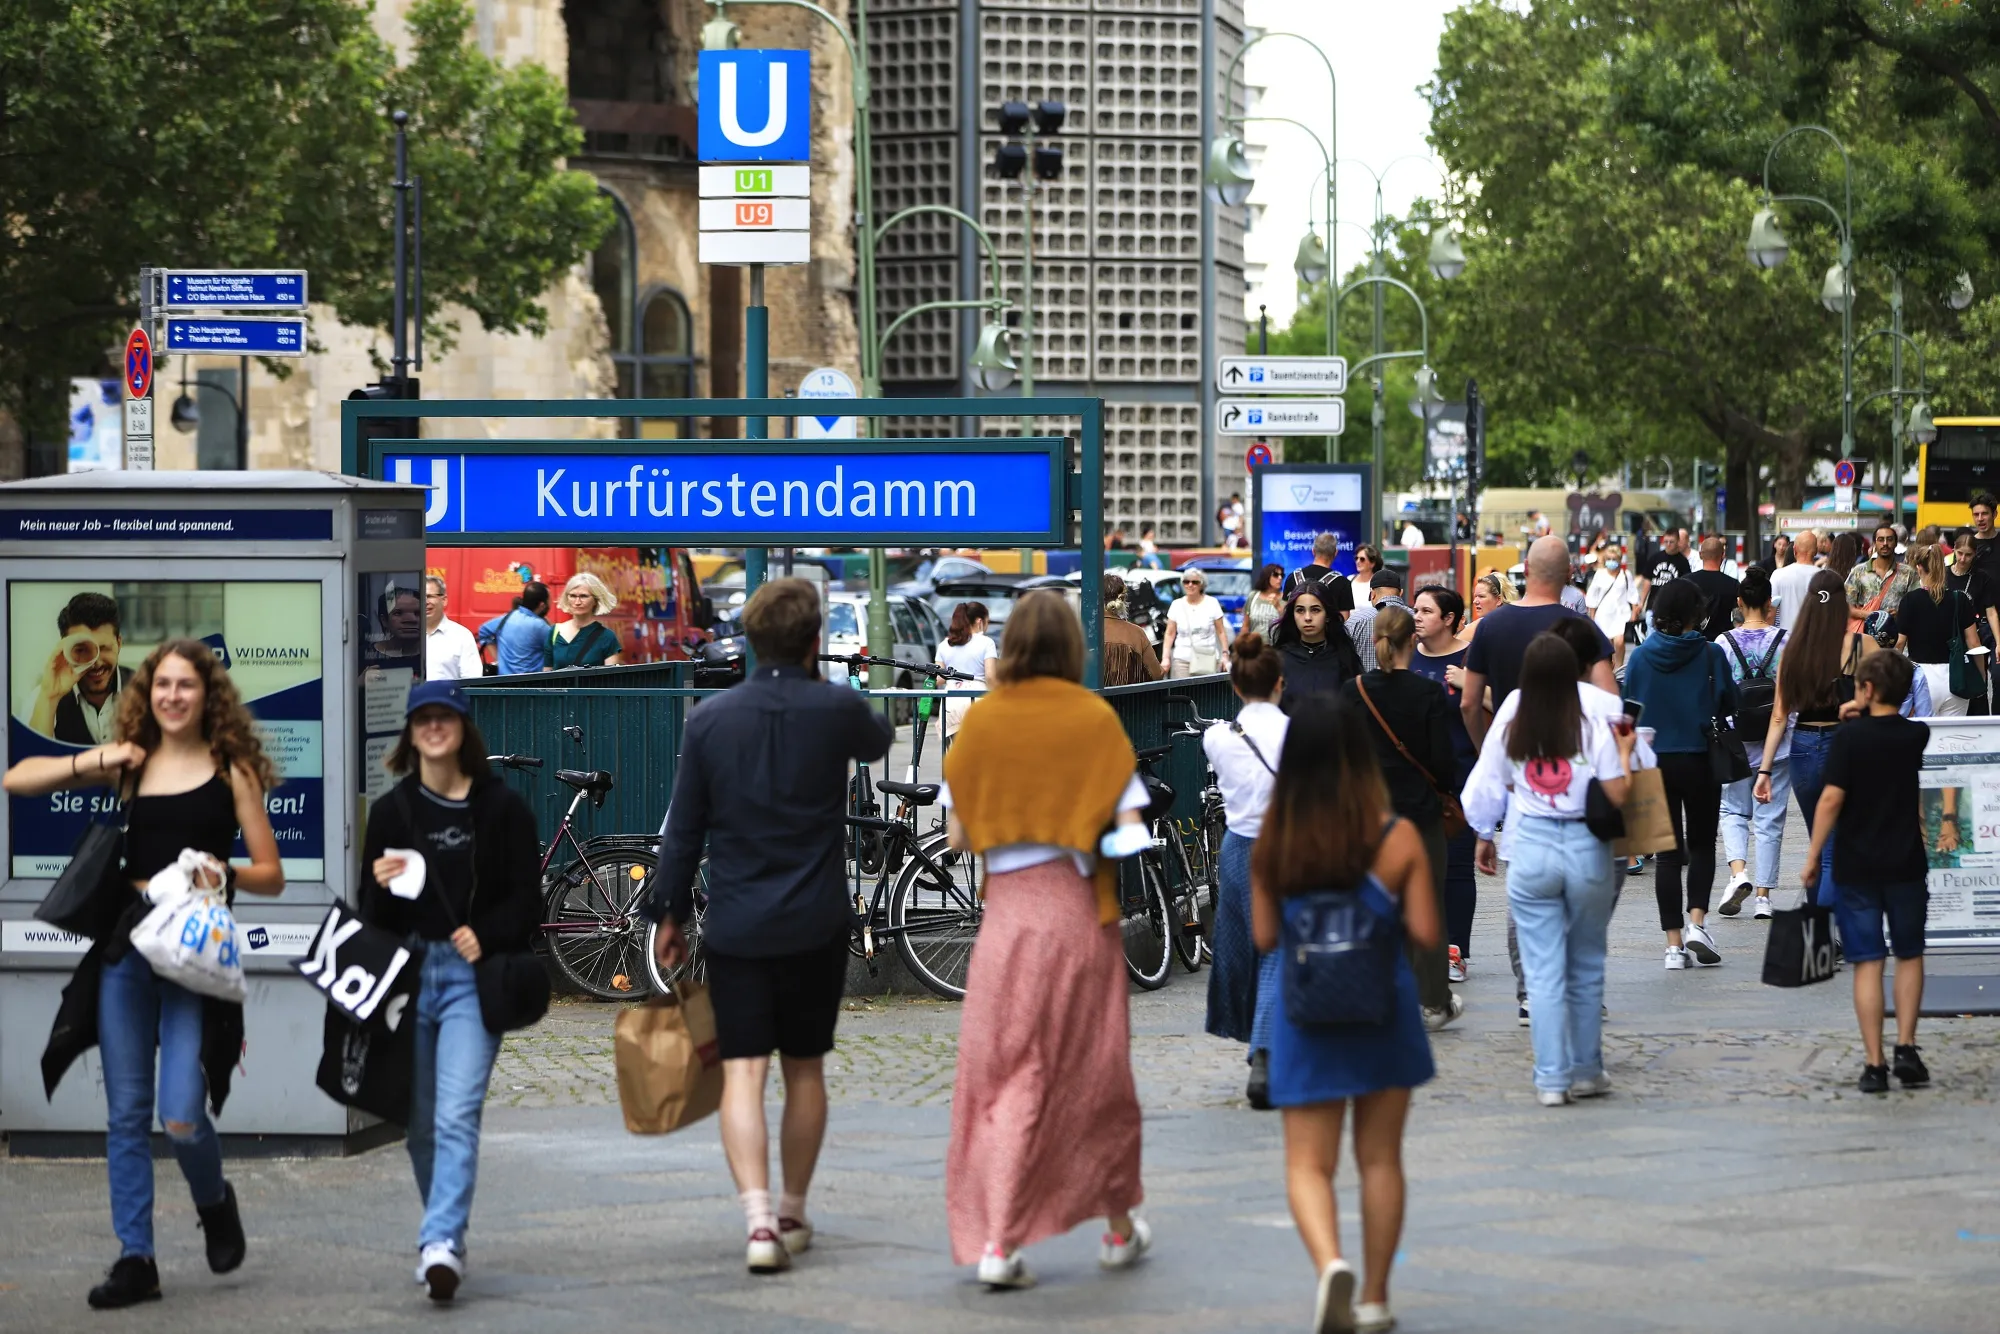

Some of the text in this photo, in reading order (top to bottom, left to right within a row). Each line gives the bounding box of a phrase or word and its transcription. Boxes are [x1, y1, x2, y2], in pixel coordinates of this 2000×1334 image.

[719, 62, 787, 147] U
[739, 172, 768, 190] U1
[740, 206, 769, 223] U9
[212, 277, 221, 285] für
[221, 277, 250, 286] Fotografie
[231, 284, 254, 293] Stiftung
[188, 326, 200, 334] Zoo
[201, 327, 240, 336] Haupteingang
[189, 335, 211, 343] Theater
[223, 336, 248, 344] Westens
[821, 375, 834, 386] 13
[1270, 369, 1340, 381] Tauentzienstraße
[1267, 411, 1319, 422] Rankestraße
[537, 464, 976, 518] Kurfürstendamm
[20, 519, 46, 531] Mein
[49, 520, 80, 531] neuer
[82, 519, 101, 531] Job
[112, 519, 153, 531] flexibel
[155, 519, 176, 531] und
[178, 519, 234, 533] spannend.
[1283, 530, 1318, 540] Besuch
[1270, 541, 1286, 551] blu
[1288, 541, 1313, 552] Servi
[235, 647, 310, 659] WIDMANN
[283, 736, 311, 744] Catering
[50, 789, 84, 813] Sie
